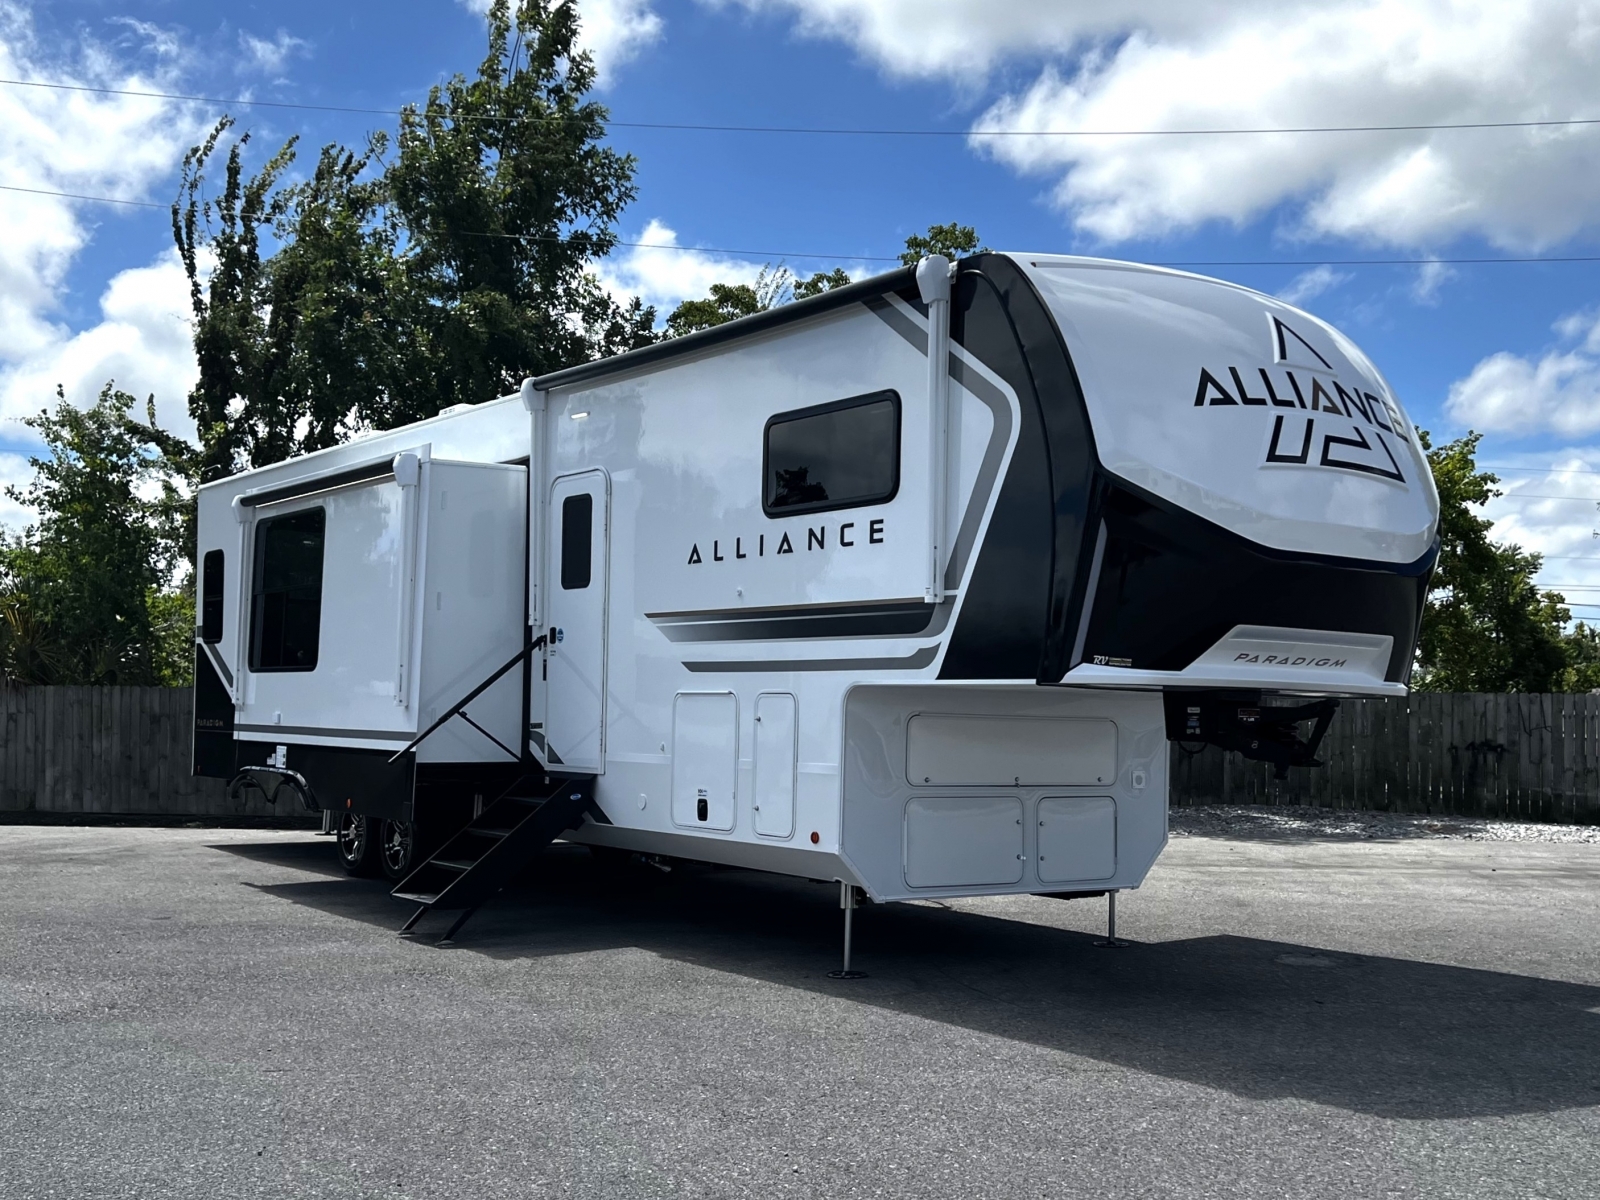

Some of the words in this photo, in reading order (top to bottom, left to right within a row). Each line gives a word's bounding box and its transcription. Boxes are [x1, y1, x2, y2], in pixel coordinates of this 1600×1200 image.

[1194, 366, 1410, 444] ALLIANCE
[687, 518, 884, 565] ALLIANCE
[1093, 655, 1109, 665] RV
[1233, 652, 1347, 668] PARADIGM
